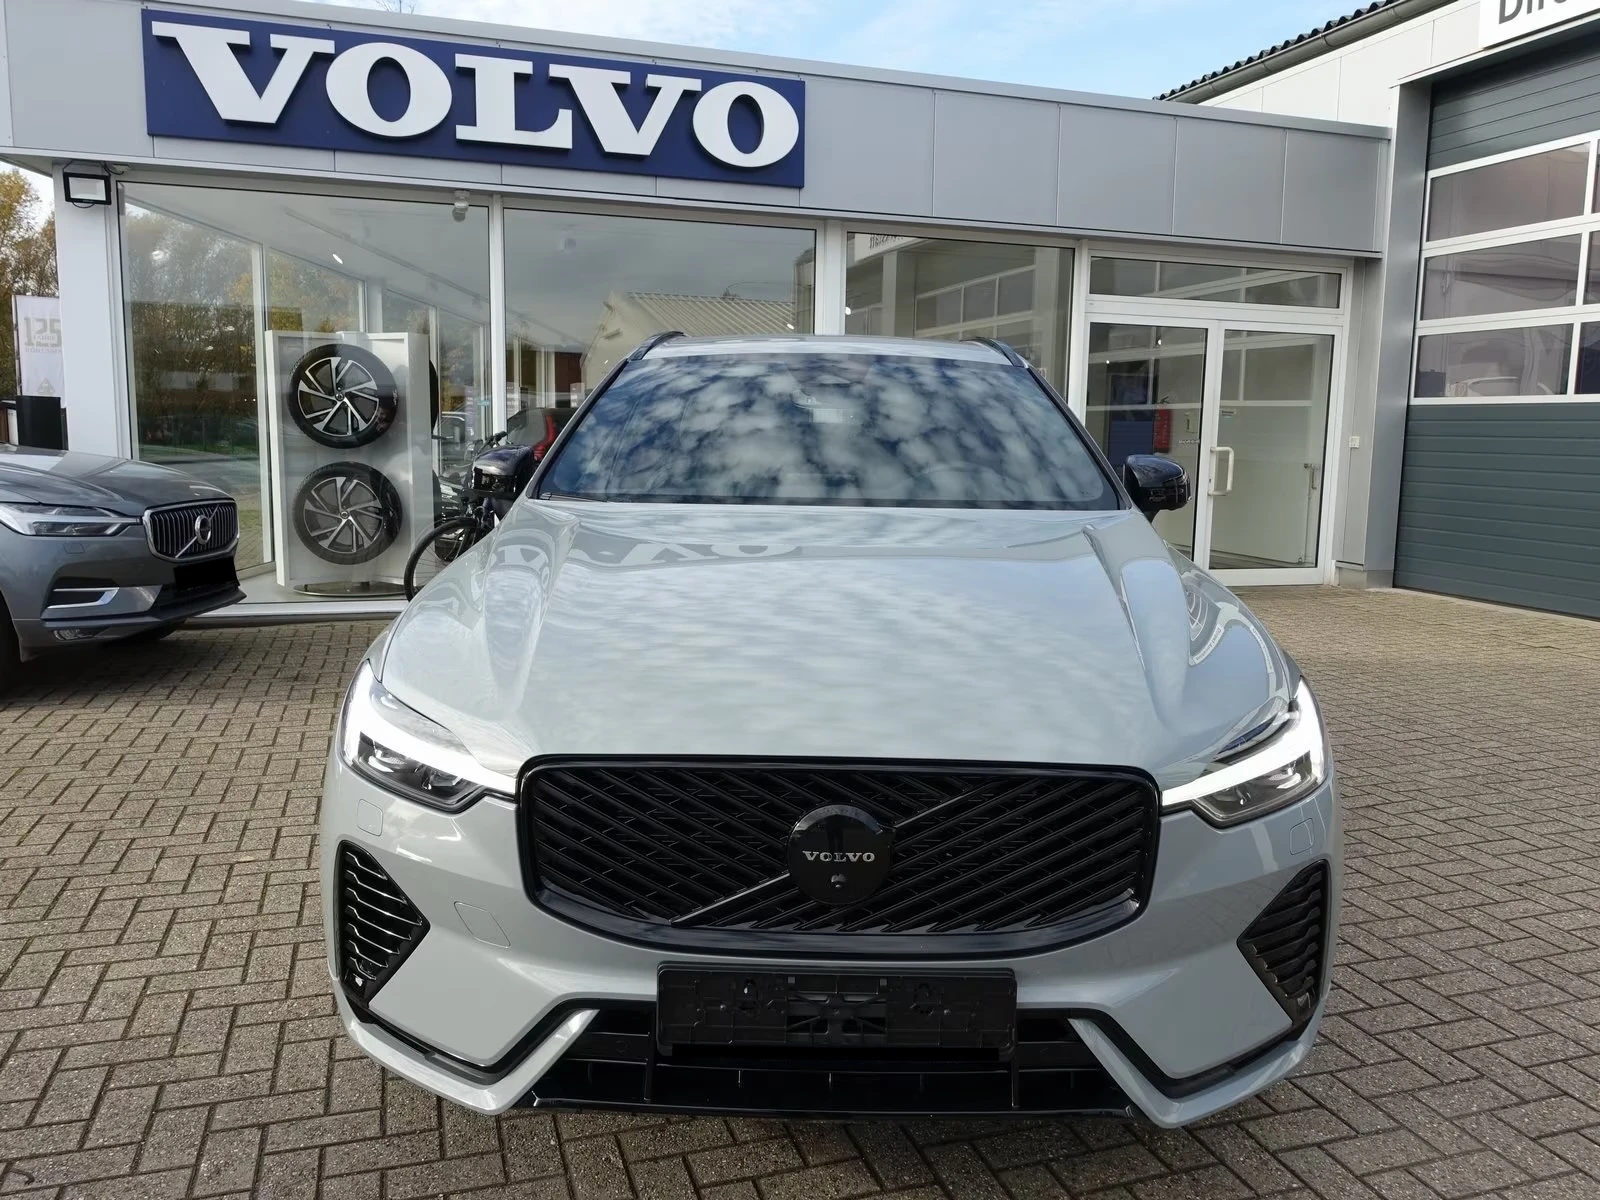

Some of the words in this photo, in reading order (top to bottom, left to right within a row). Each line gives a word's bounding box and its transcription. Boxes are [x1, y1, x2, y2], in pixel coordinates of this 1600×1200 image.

[151, 21, 800, 168] VOLVO
[24, 316, 62, 348] 125
[802, 850, 876, 862] VOLVO
